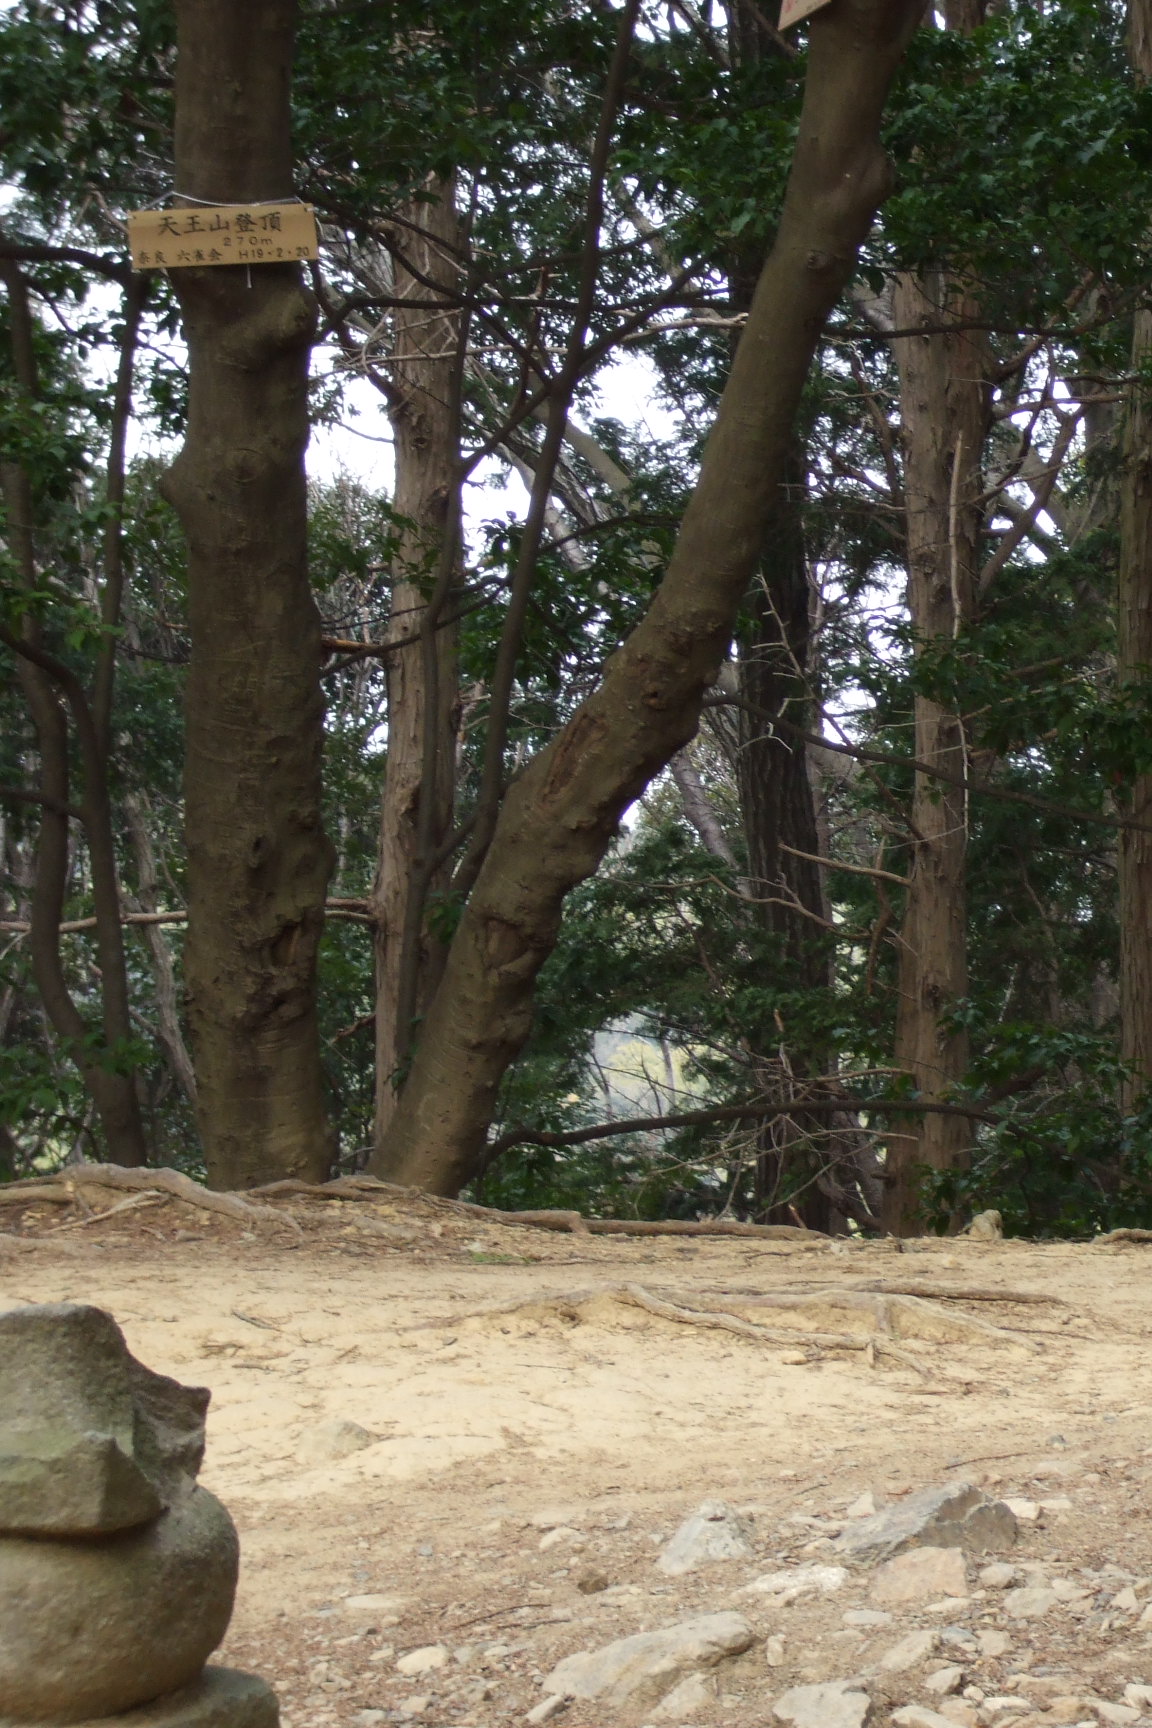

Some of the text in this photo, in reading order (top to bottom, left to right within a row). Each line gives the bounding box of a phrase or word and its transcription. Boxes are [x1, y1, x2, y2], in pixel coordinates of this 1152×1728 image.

[158, 211, 283, 237] 天王山登頂
